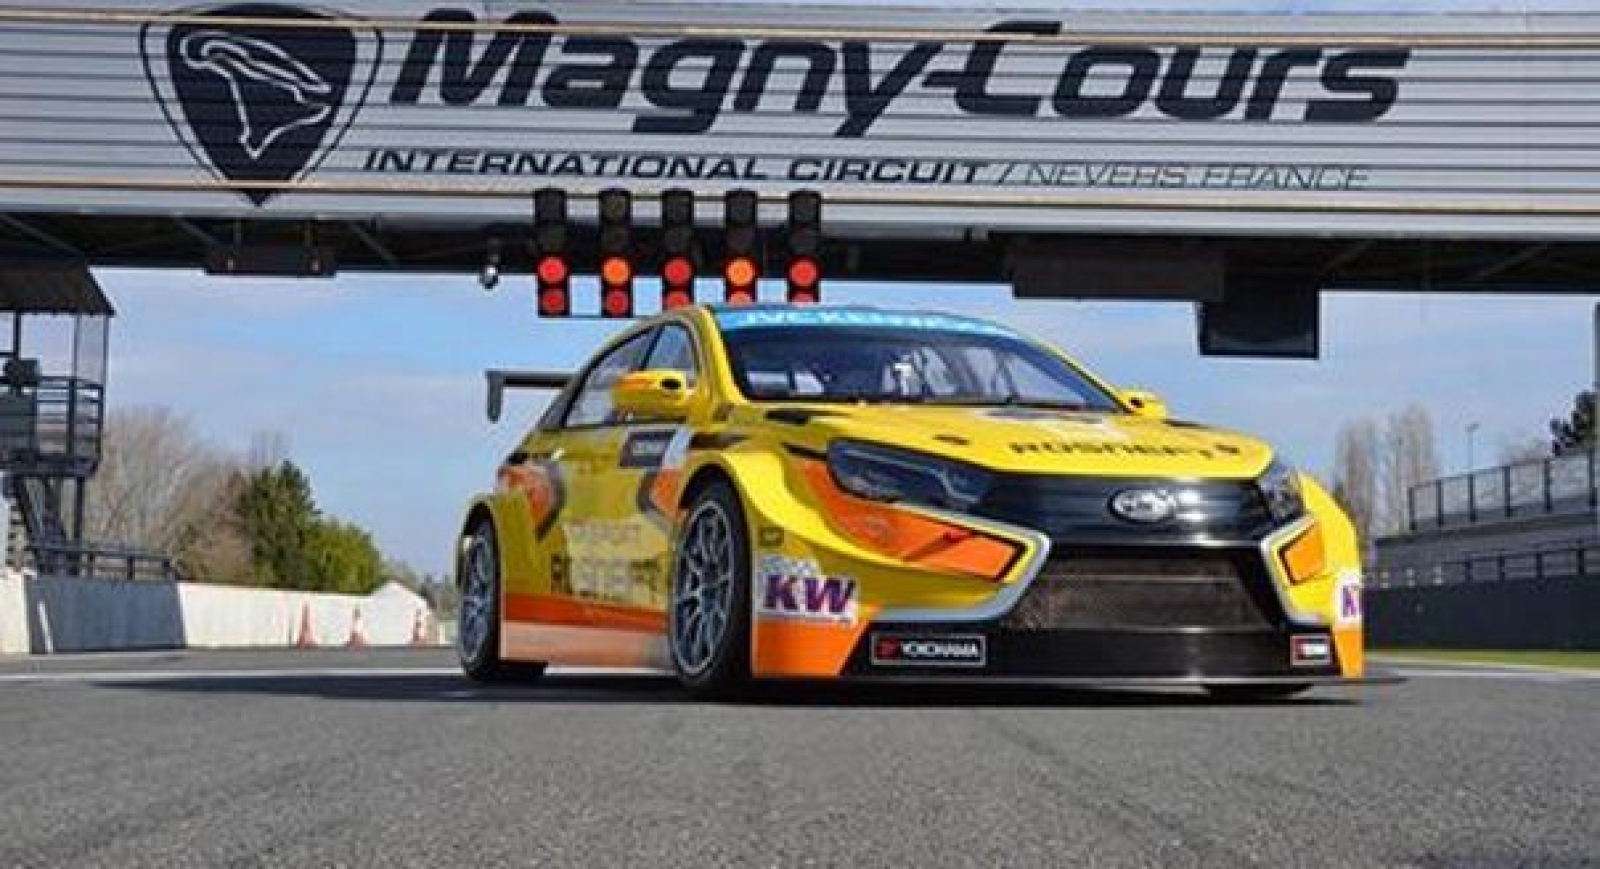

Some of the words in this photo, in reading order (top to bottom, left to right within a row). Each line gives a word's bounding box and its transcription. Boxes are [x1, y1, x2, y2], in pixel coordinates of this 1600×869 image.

[391, 7, 1411, 138] Magny-Cours
[363, 149, 767, 180] INTERNATIONAL
[787, 157, 988, 184] CIRCUIT
[1199, 163, 1369, 191] FRANCE
[764, 574, 857, 614] KW
